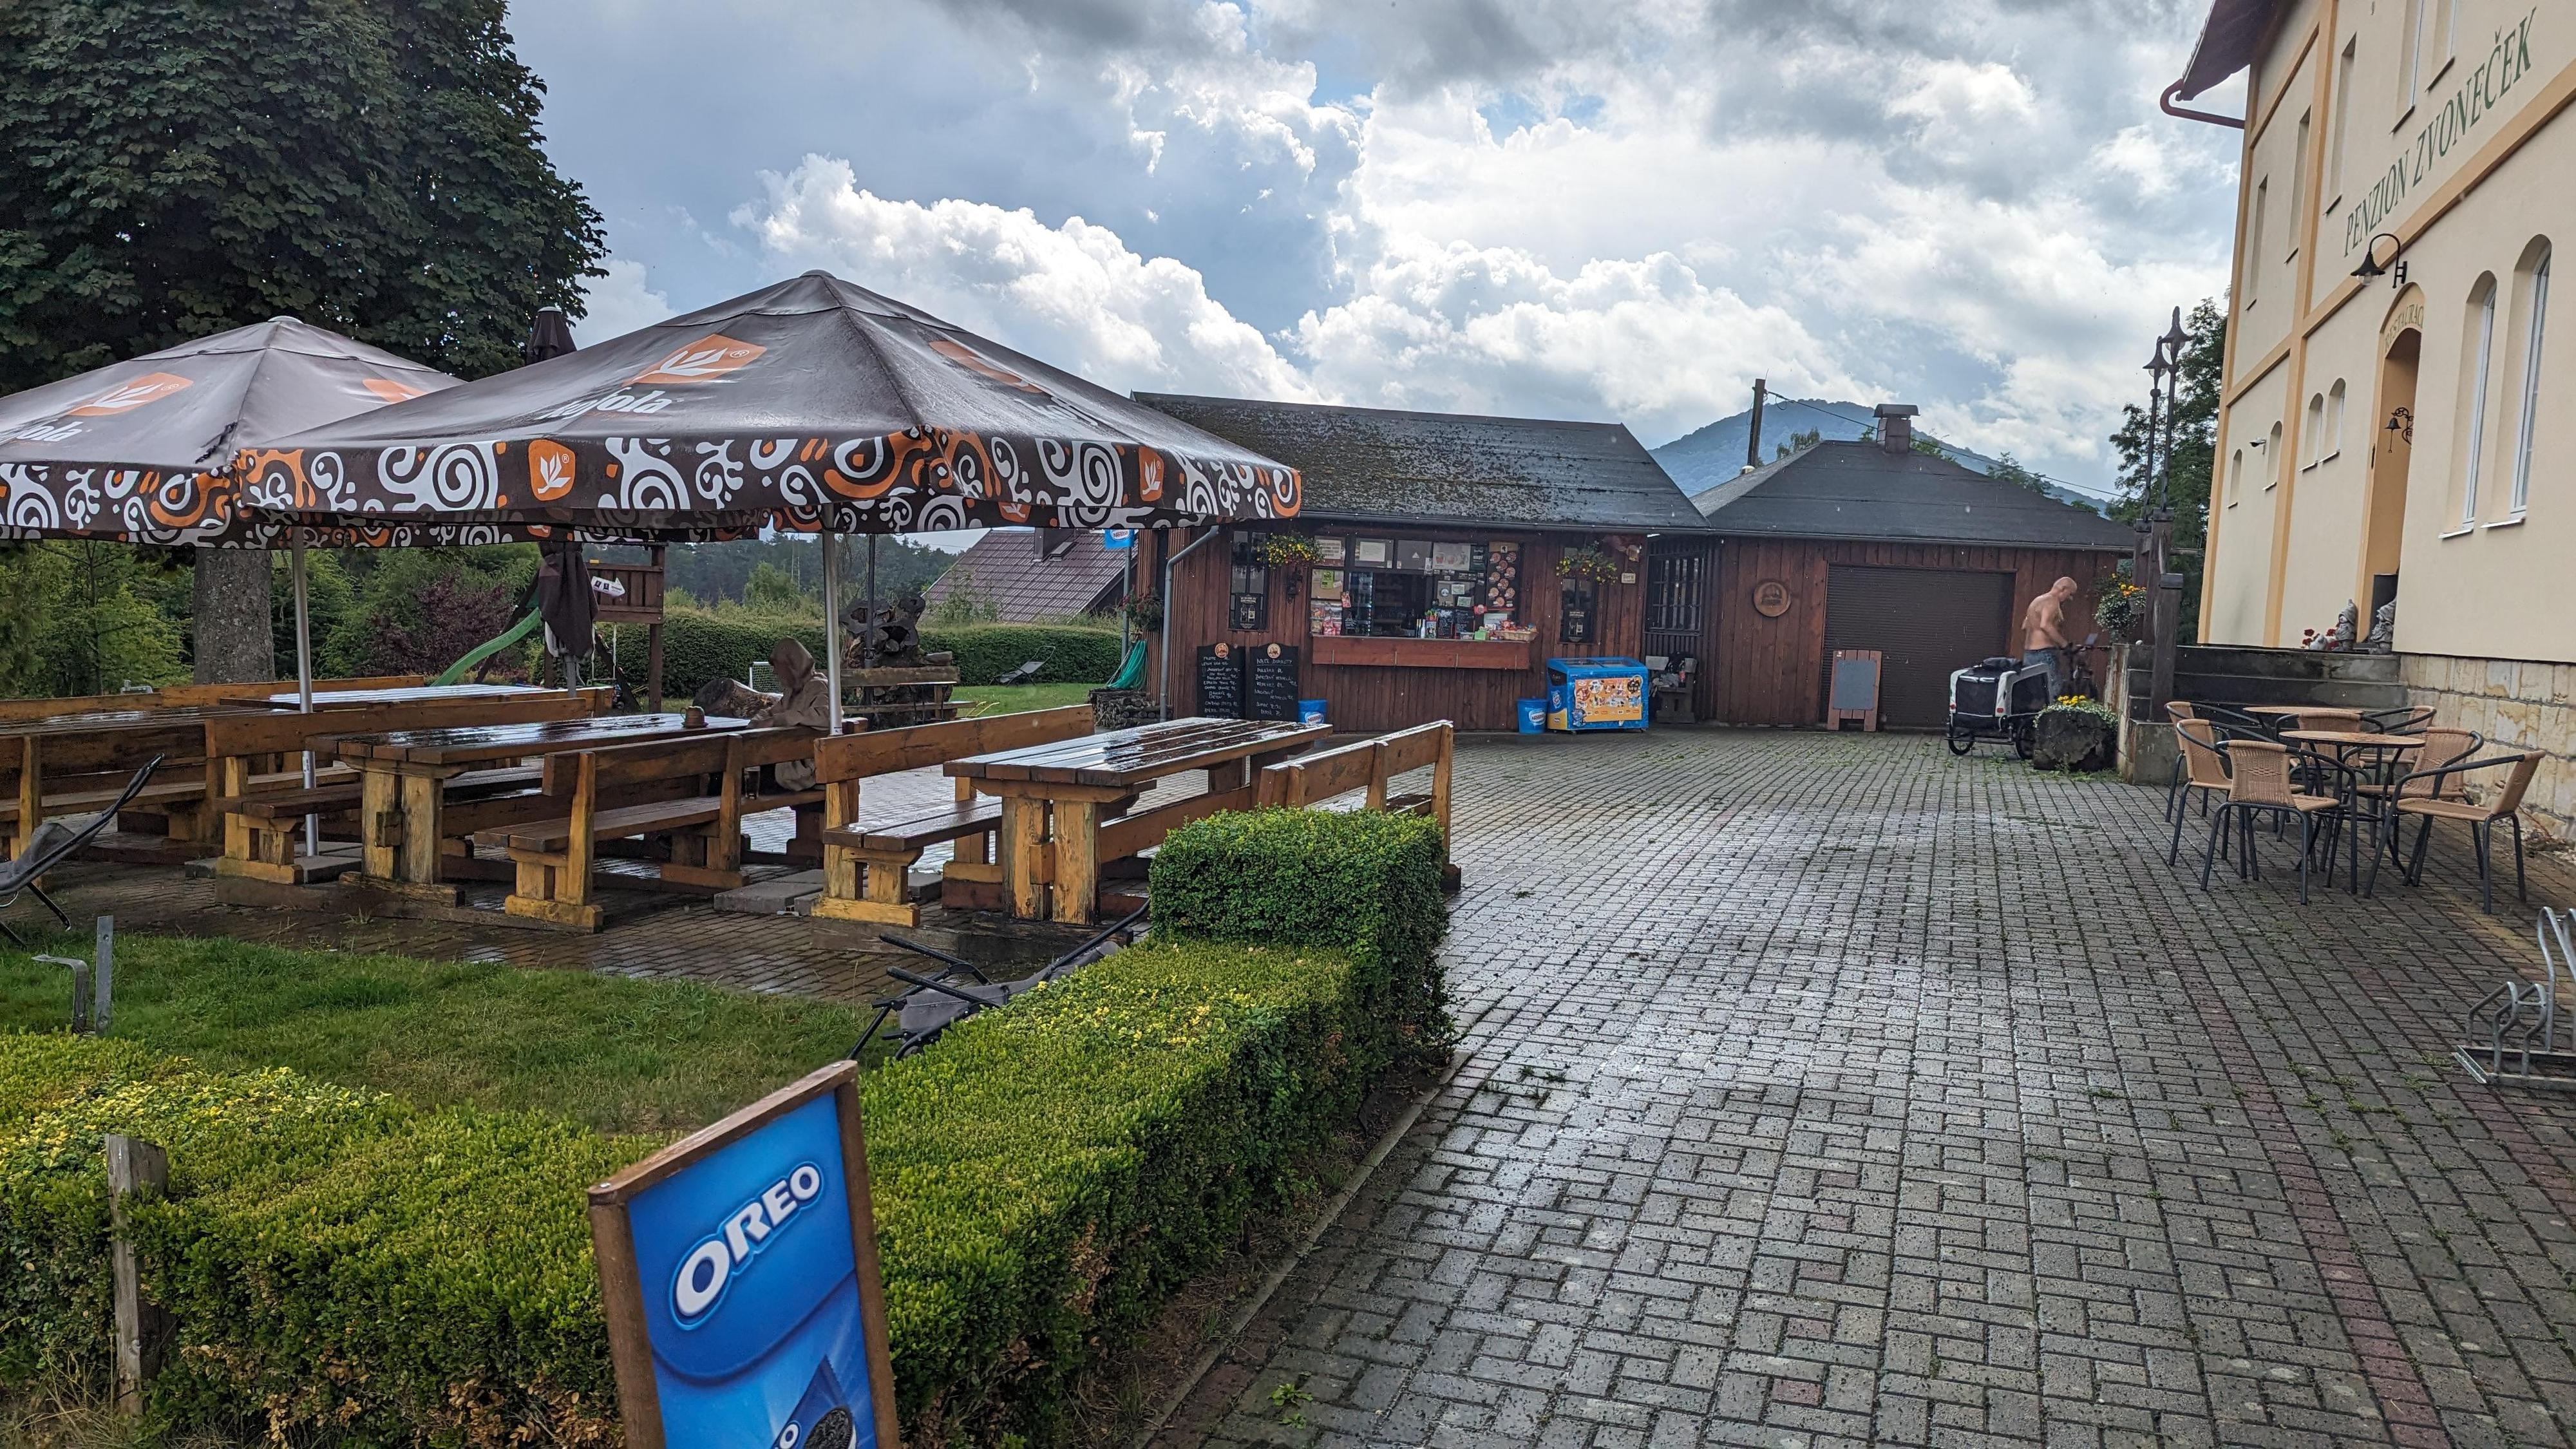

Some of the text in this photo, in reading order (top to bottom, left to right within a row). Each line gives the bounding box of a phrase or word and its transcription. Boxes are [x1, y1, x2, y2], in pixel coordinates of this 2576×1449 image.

[2344, 6, 2539, 258] PENZION ZVONEČEK
[676, 1166, 820, 1317] OREO
